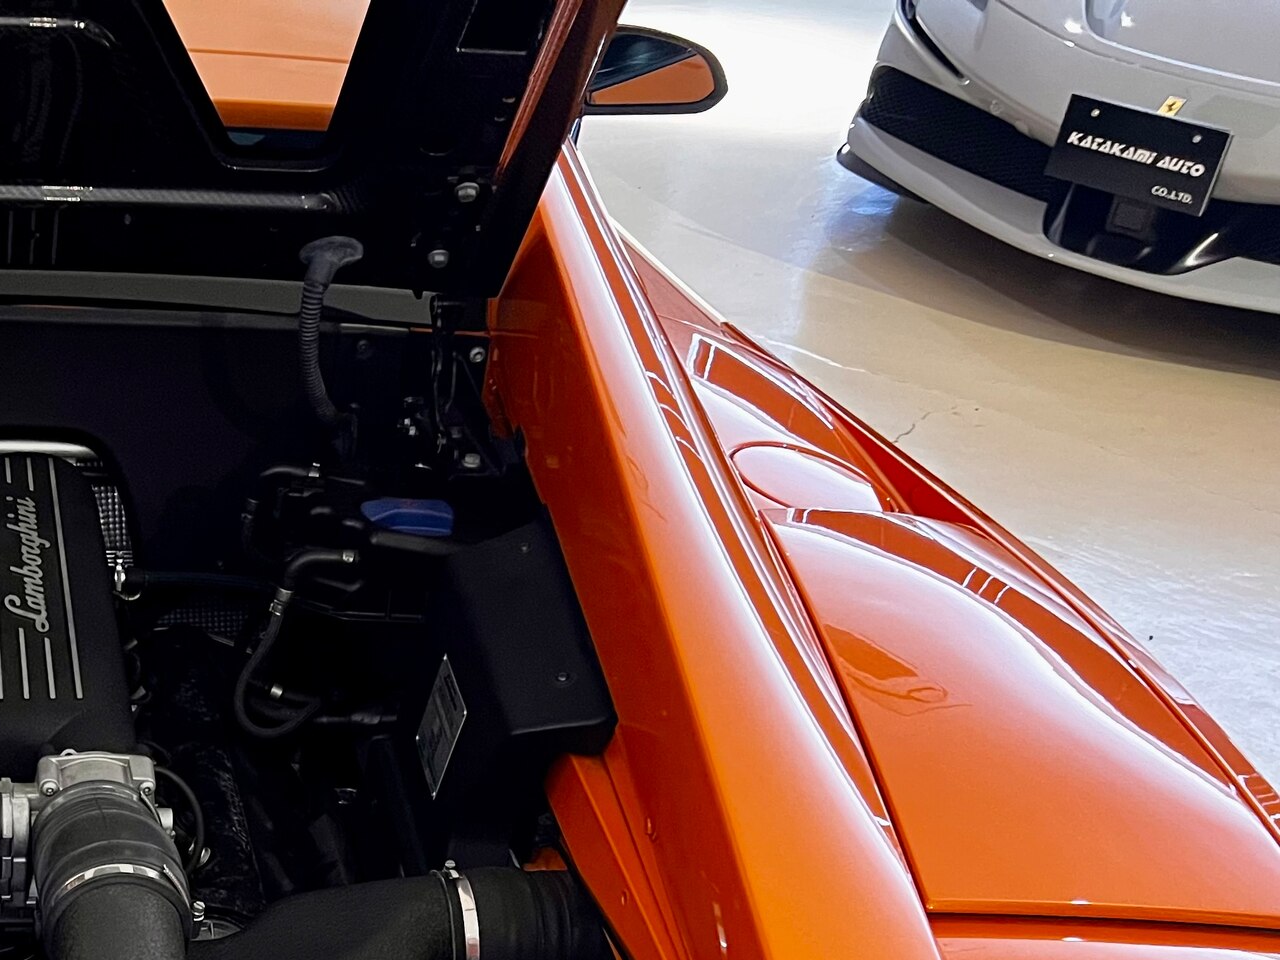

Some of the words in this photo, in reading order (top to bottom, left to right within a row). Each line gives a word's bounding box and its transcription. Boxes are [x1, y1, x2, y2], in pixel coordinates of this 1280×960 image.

[1067, 131, 1157, 165] KATAKAMI
[1156, 155, 1206, 177] AUTO
[4, 495, 51, 633] Lamborghini
